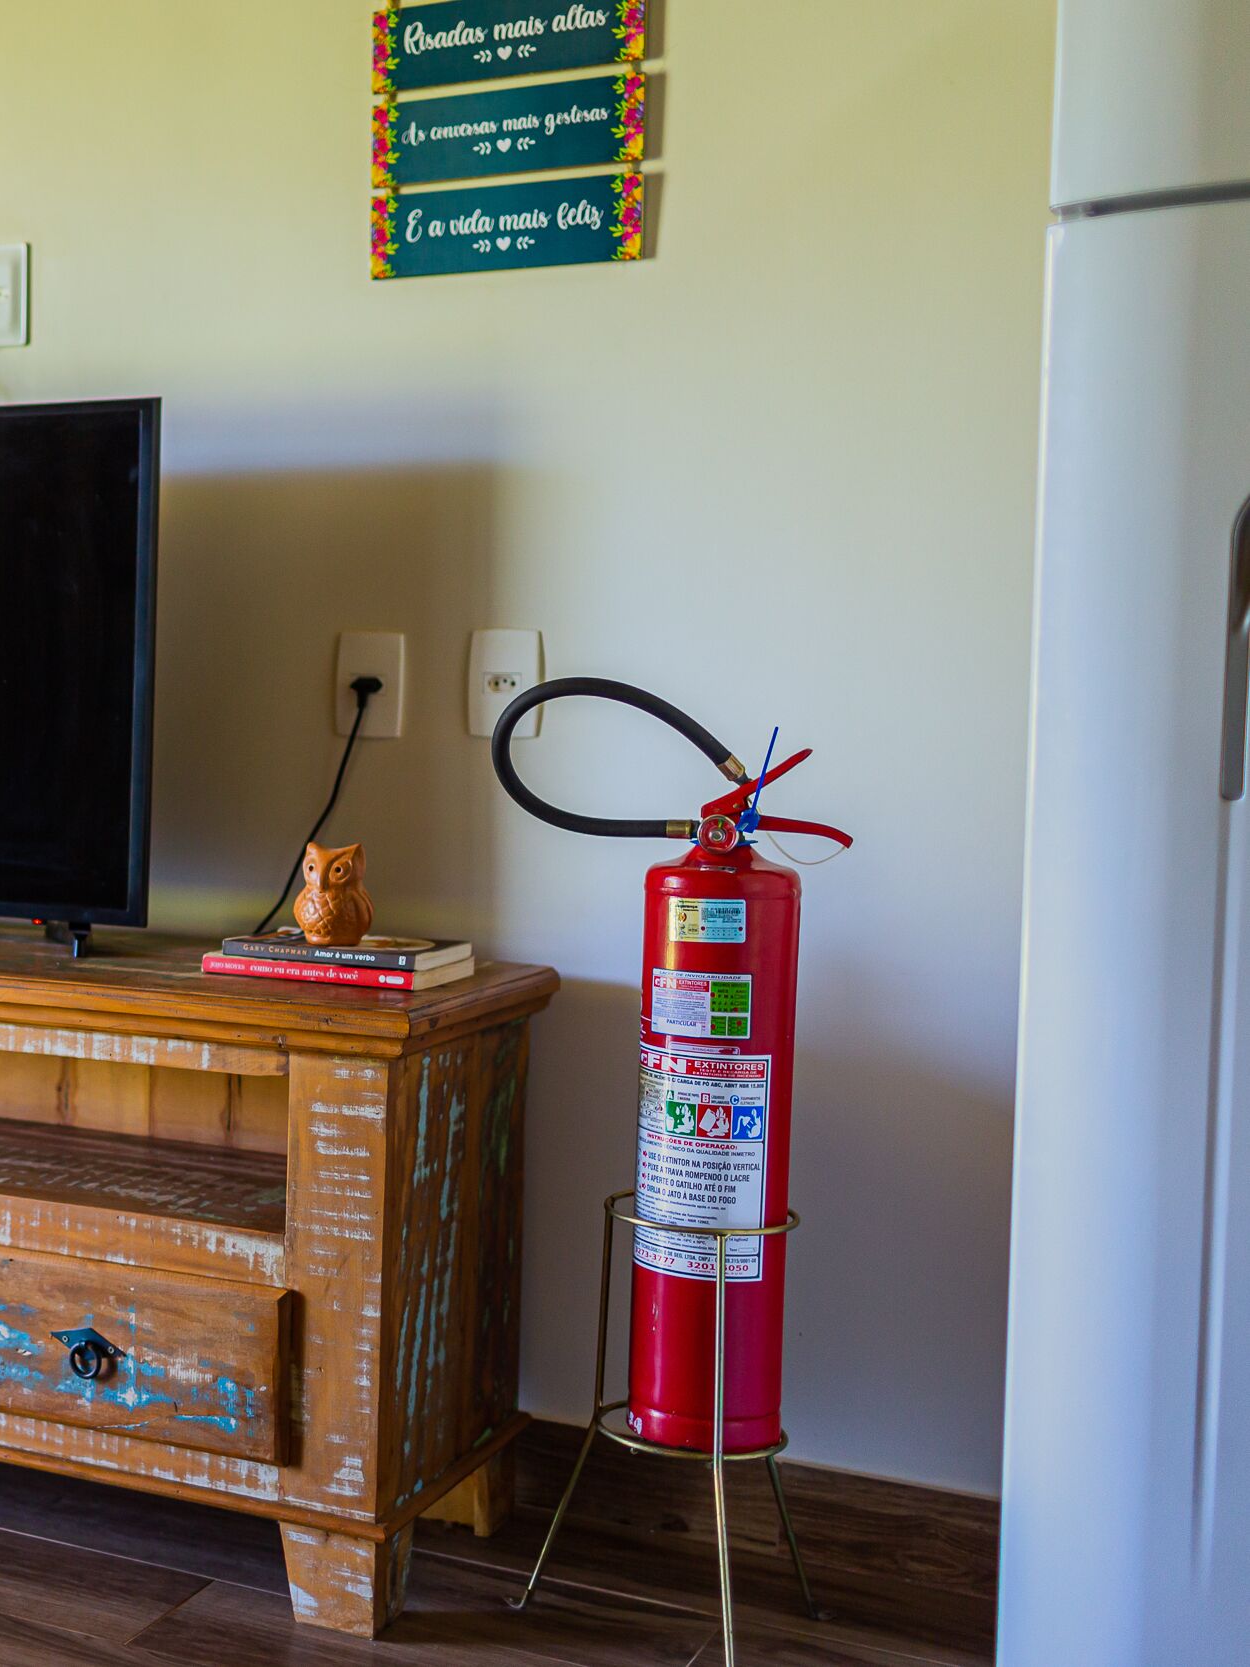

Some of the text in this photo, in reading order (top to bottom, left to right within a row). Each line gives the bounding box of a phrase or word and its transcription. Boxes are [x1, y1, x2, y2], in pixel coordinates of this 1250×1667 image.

[403, 3, 610, 56] Risadas mais altas
[401, 121, 427, 147] As
[502, 113, 543, 133] mais
[544, 104, 612, 136] gostosas
[405, 199, 605, 244] E a vida mais feliz
[314, 949, 334, 960] Amor
[342, 953, 353, 961] um
[353, 952, 376, 963] verbo
[250, 965, 359, 981] como eu era antes de você
[678, 979, 708, 987] EXTINTORES
[666, 1018, 698, 1028] PARTICULAR
[694, 1060, 764, 1071] EXTINTORES
[702, 1093, 709, 1103] B
[731, 1095, 739, 1104] C
[695, 1148, 730, 1157] QUALIDADE
[648, 1151, 657, 1161] USE
[662, 1155, 691, 1167] EXTINTOR
[691, 1160, 701, 1169] NA
[702, 1161, 731, 1172] POSIÇÃO
[733, 1162, 761, 1171] VERTICAL
[647, 1162, 659, 1173] PUXE
[665, 1166, 684, 1178] TRAVA
[684, 1170, 721, 1182] ROMPENDO
[730, 1173, 750, 1182] LACRE
[651, 1174, 669, 1186] APERTE
[675, 1179, 703, 1191] GATILHO
[703, 1183, 716, 1193] ATÉ
[717, 1185, 723, 1193] O
[724, 1185, 736, 1193] FIM
[667, 1189, 682, 1199] JATO
[688, 1193, 706, 1203] BASE
[707, 1195, 717, 1204] DO
[718, 1196, 737, 1205] FOGO
